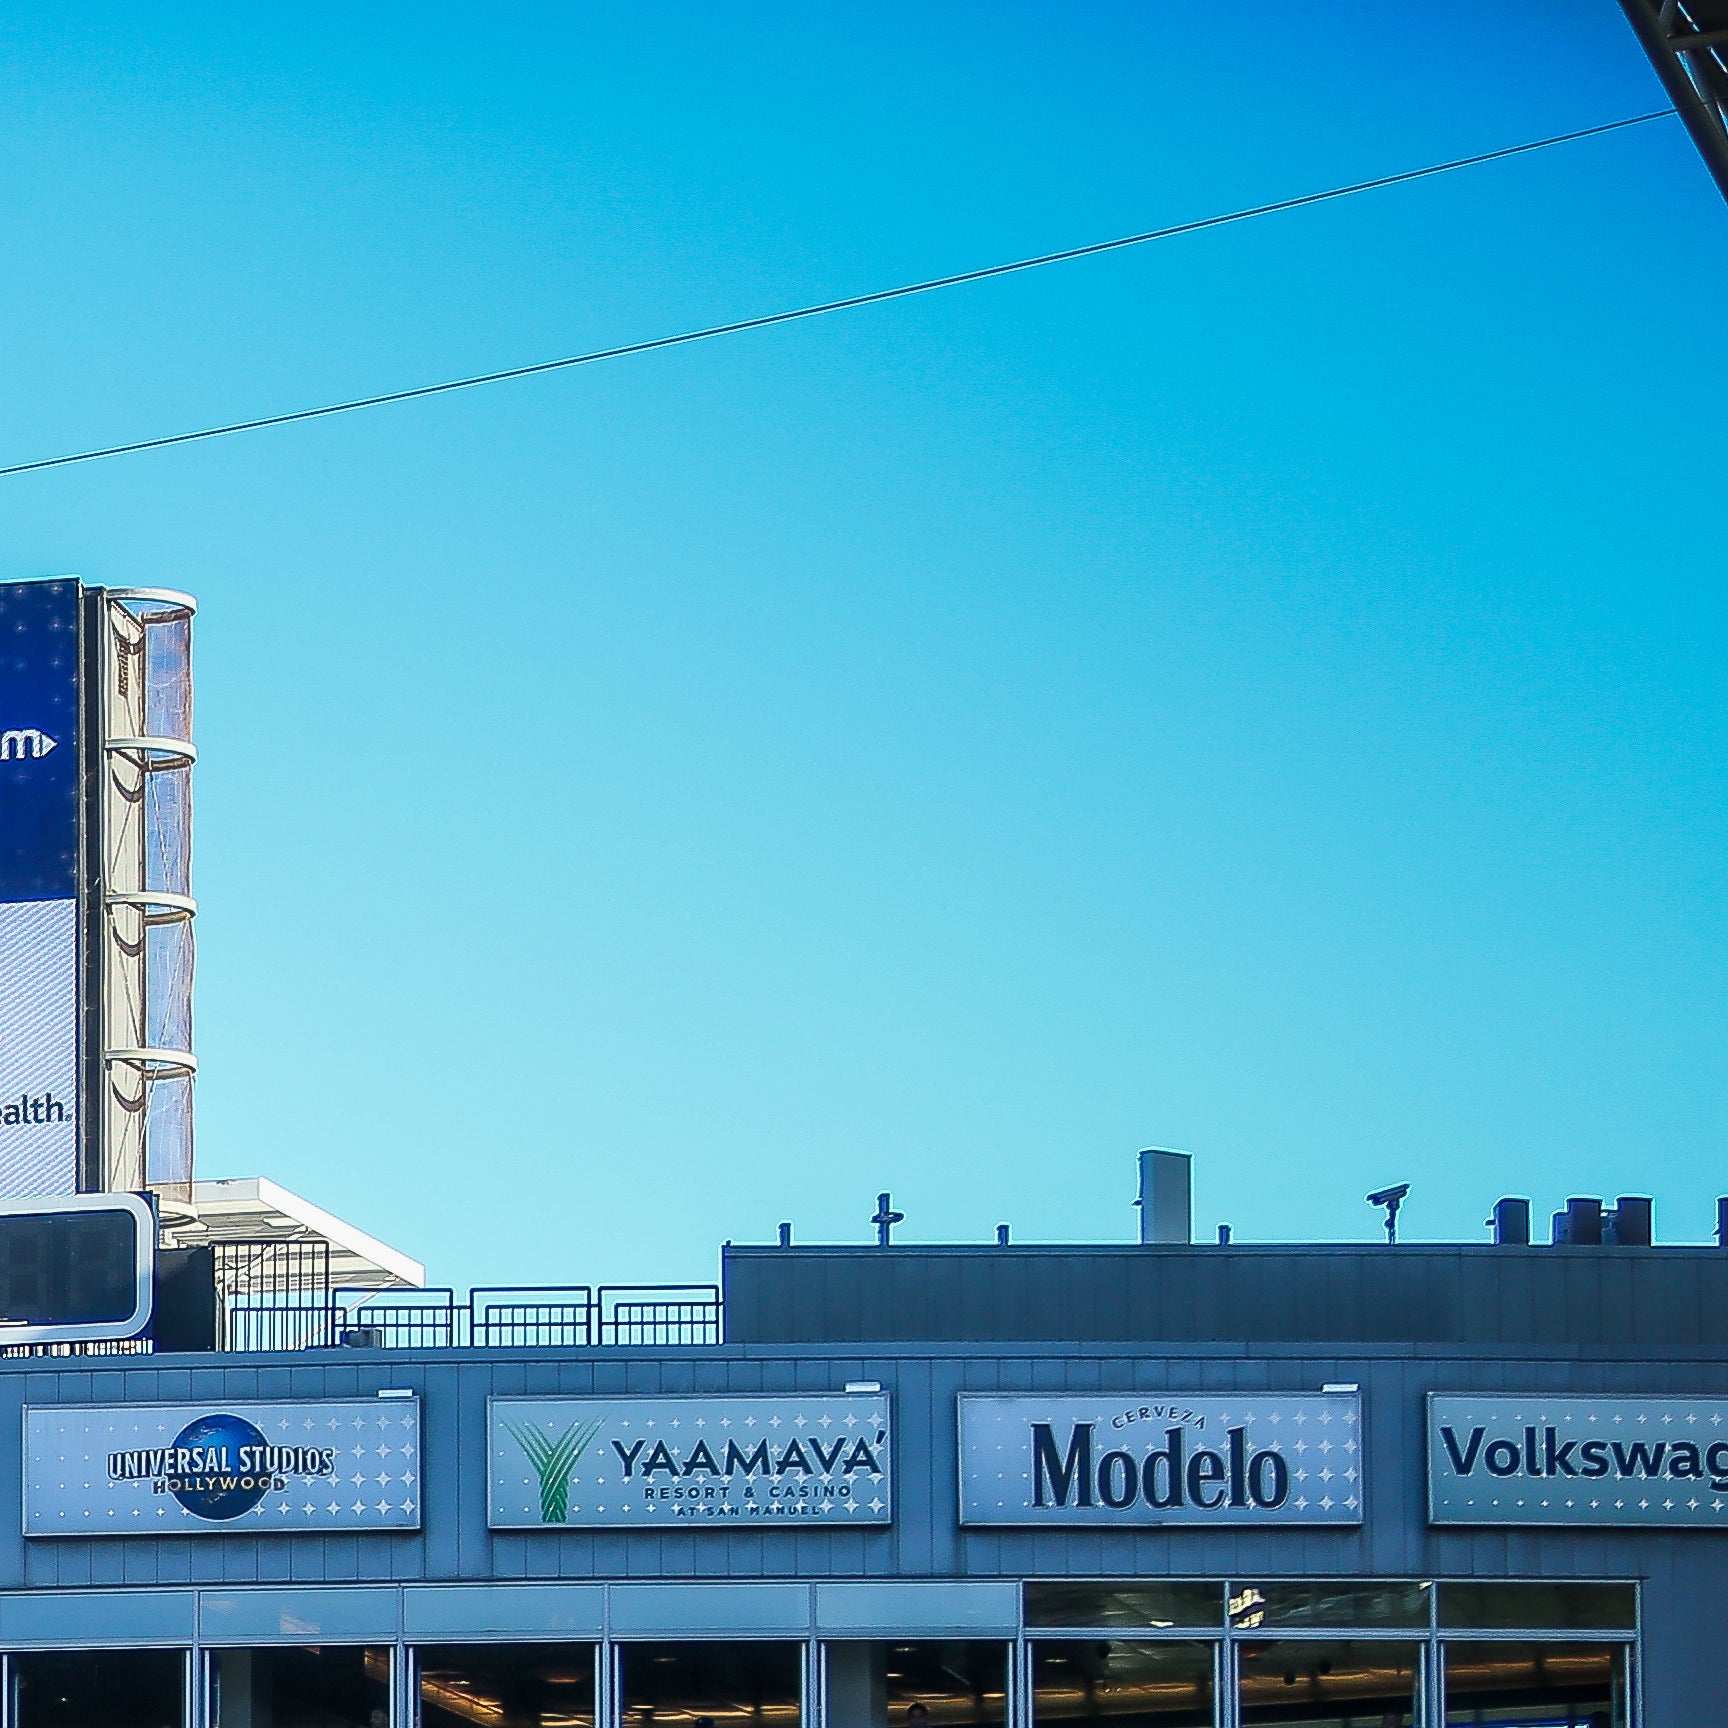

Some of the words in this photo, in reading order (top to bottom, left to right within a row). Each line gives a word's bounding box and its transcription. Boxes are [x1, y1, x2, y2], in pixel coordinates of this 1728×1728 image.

[1111, 1405, 1207, 1431] CERVEZA
[107, 1444, 233, 1480] UNIVERSAL
[239, 1445, 336, 1476] STUDIOS
[1031, 1423, 1289, 1511] Modelo
[152, 1476, 286, 1495] HOLLYWOOD
[645, 1485, 731, 1499] RESORT
[743, 1485, 756, 1499] &
[769, 1484, 852, 1499] CASINO
[676, 1504, 699, 1517] AT
[703, 1504, 740, 1517] SAN
[745, 1504, 821, 1517] MANUEL
